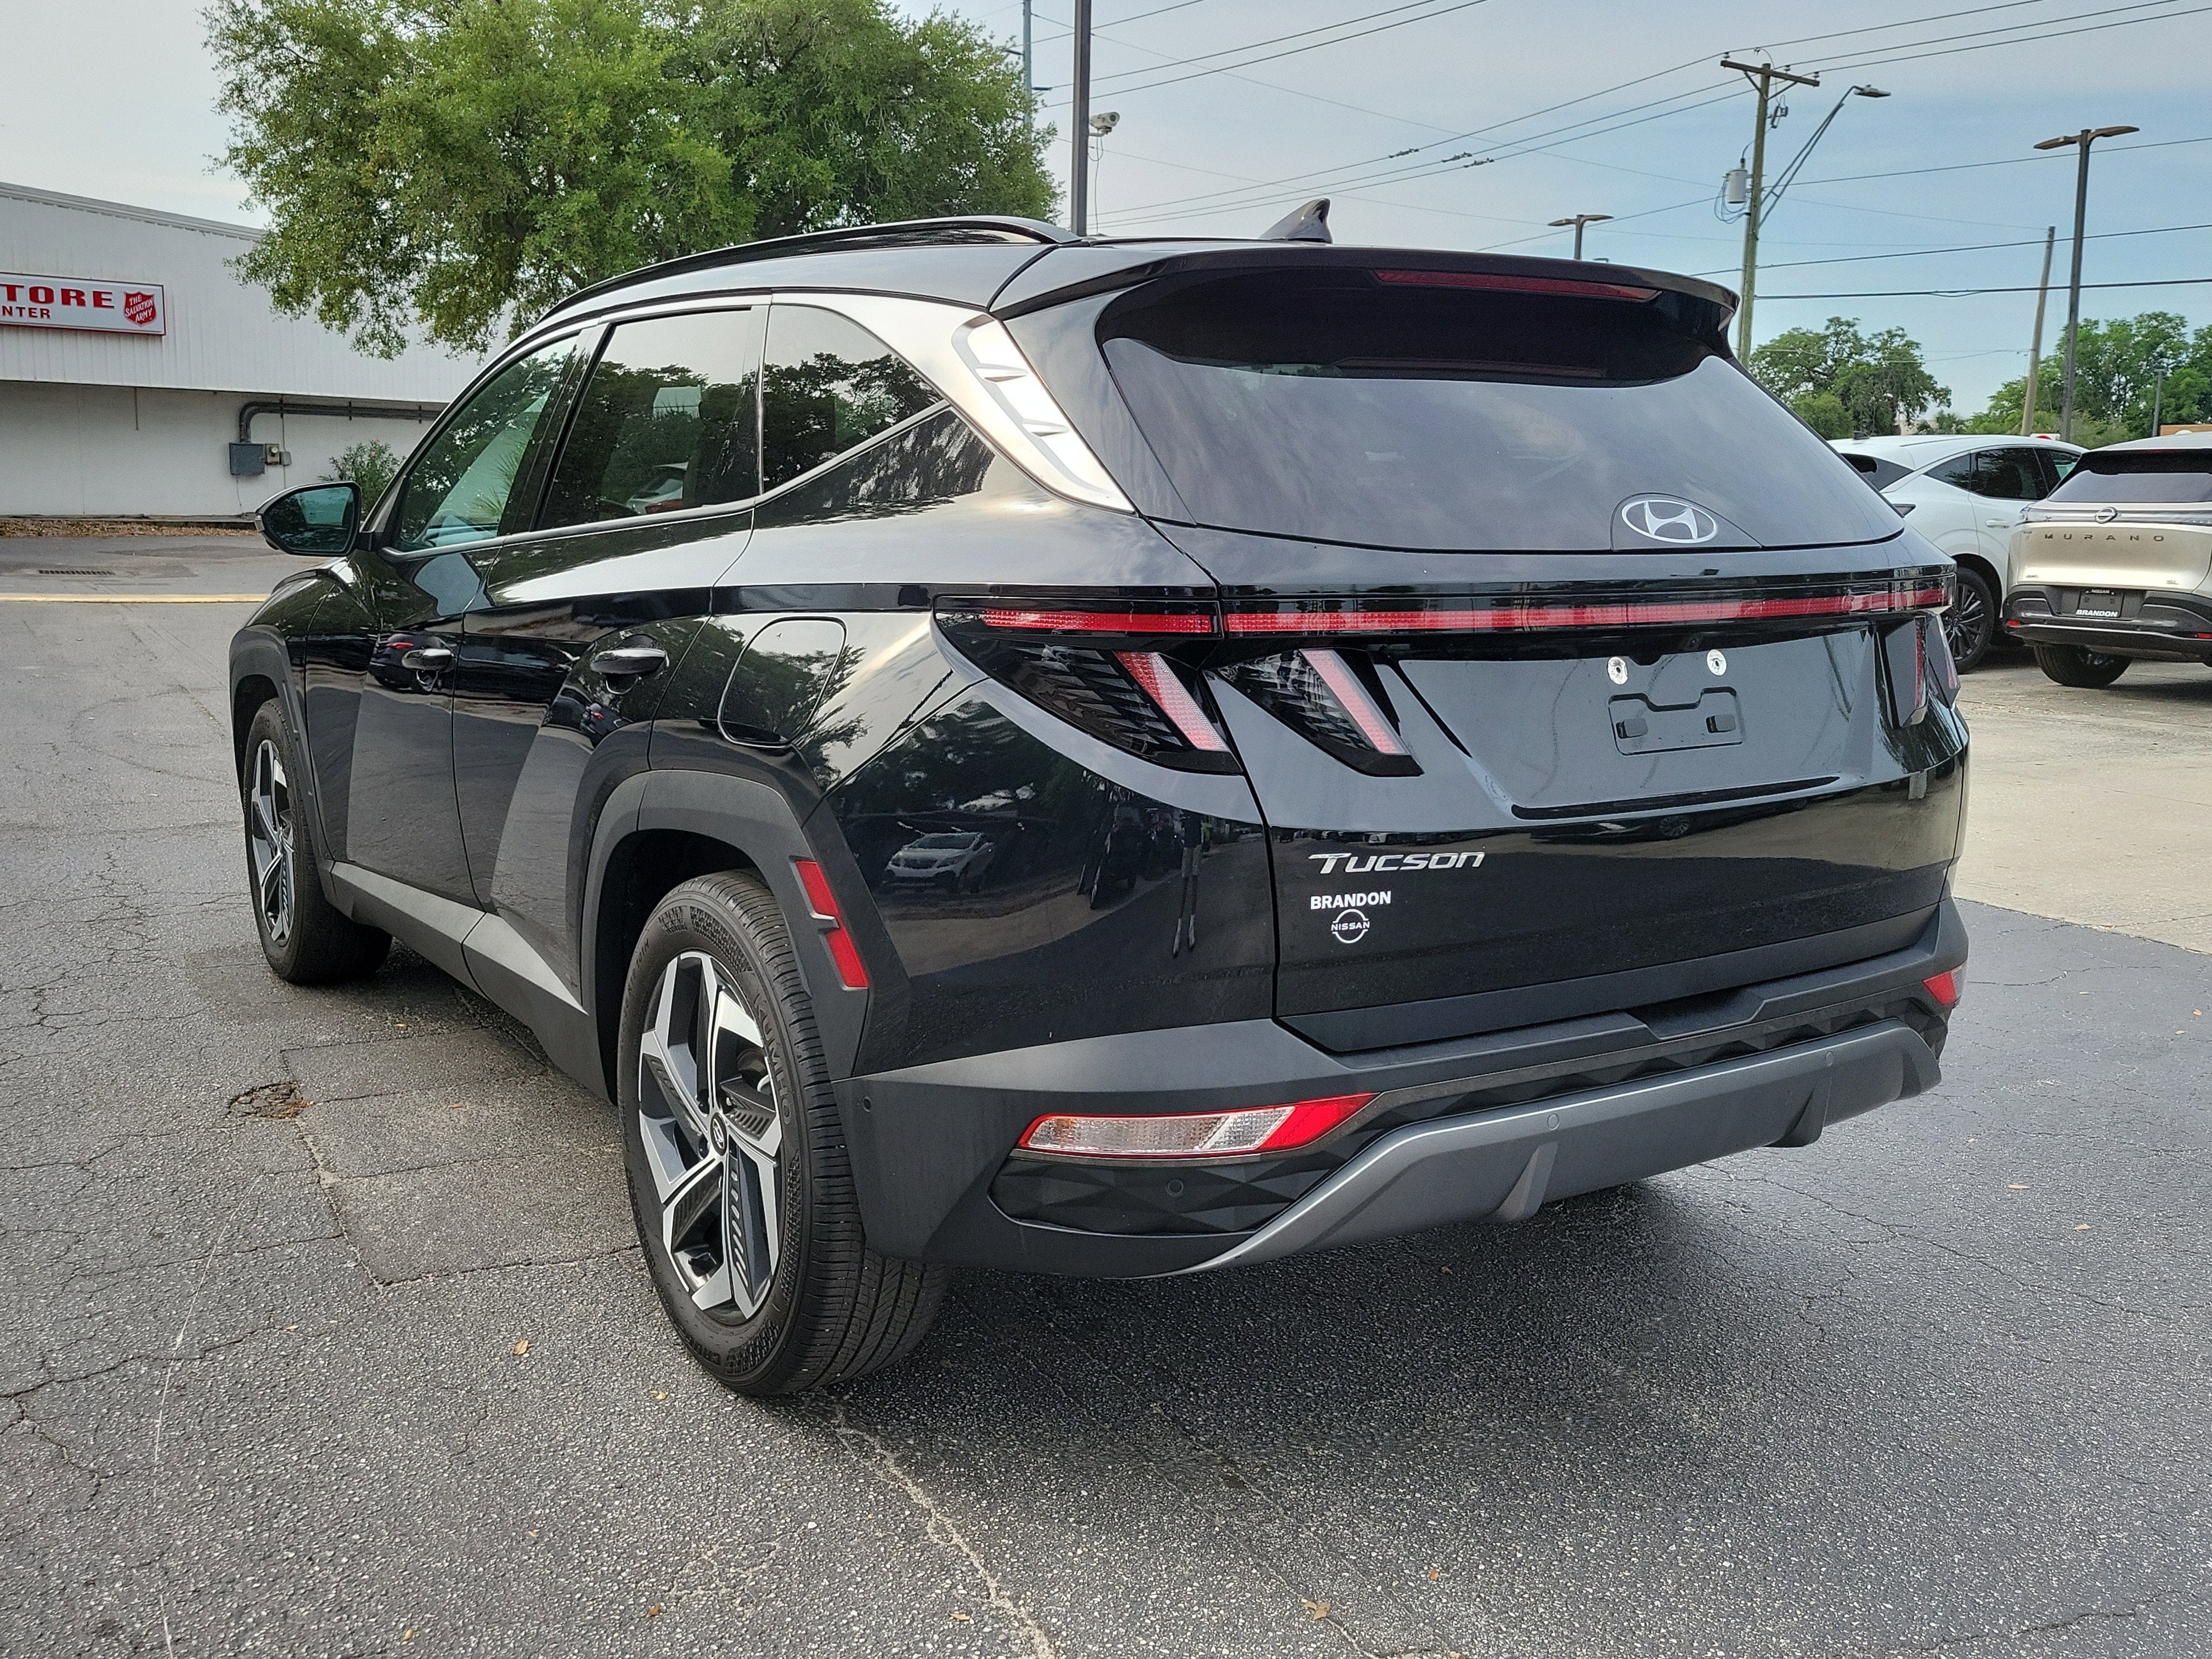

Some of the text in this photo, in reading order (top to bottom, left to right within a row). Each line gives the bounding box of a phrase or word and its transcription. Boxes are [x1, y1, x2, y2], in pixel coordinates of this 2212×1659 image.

[125, 297, 154, 317] SALVATION
[129, 294, 142, 306] THE
[2, 305, 51, 319] NTER
[135, 307, 153, 323] ARMY
[2044, 533, 2164, 542] MURANO
[2075, 609, 2118, 617] BRANDON
[1308, 851, 1485, 874] TUCSON
[1310, 890, 1392, 910] BRANDON
[1330, 921, 1370, 932] NISSAN
[753, 993, 791, 1125] KUMHO
